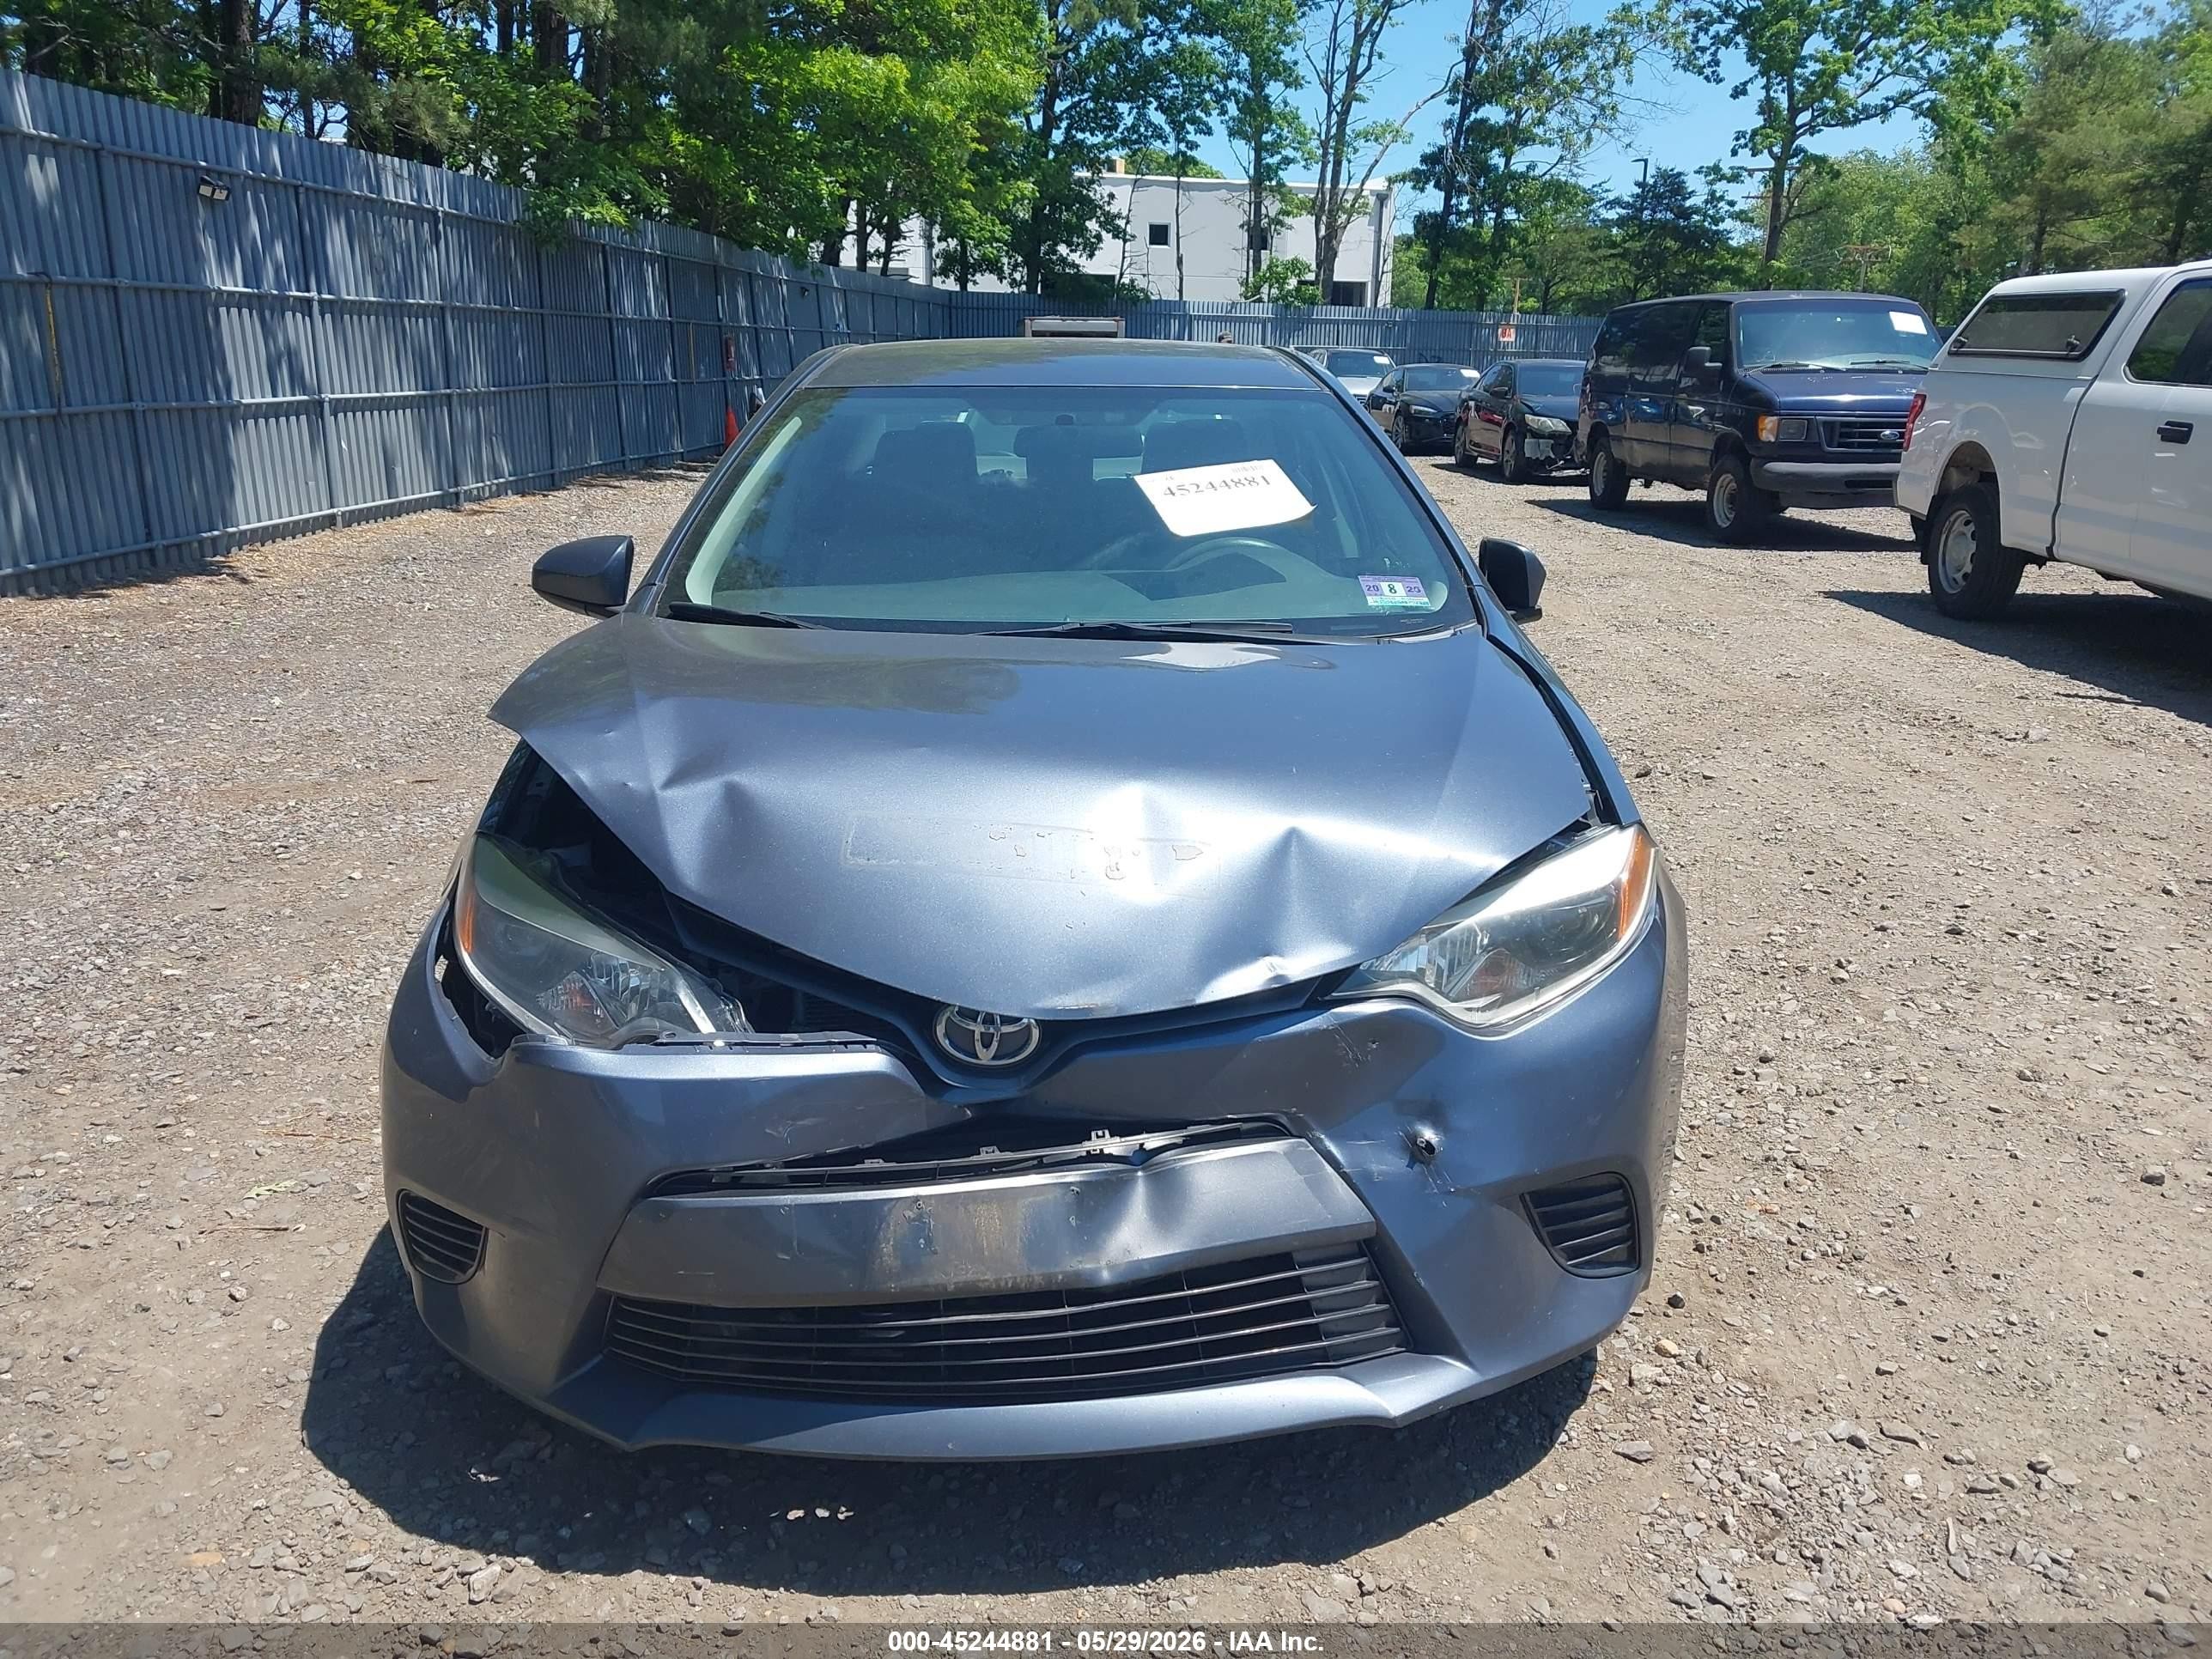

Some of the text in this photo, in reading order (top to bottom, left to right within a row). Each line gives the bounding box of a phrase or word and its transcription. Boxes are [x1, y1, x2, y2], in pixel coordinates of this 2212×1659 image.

[1163, 475, 1271, 497] 45244881
[1365, 584, 1380, 592] 20
[1388, 583, 1397, 594] 8
